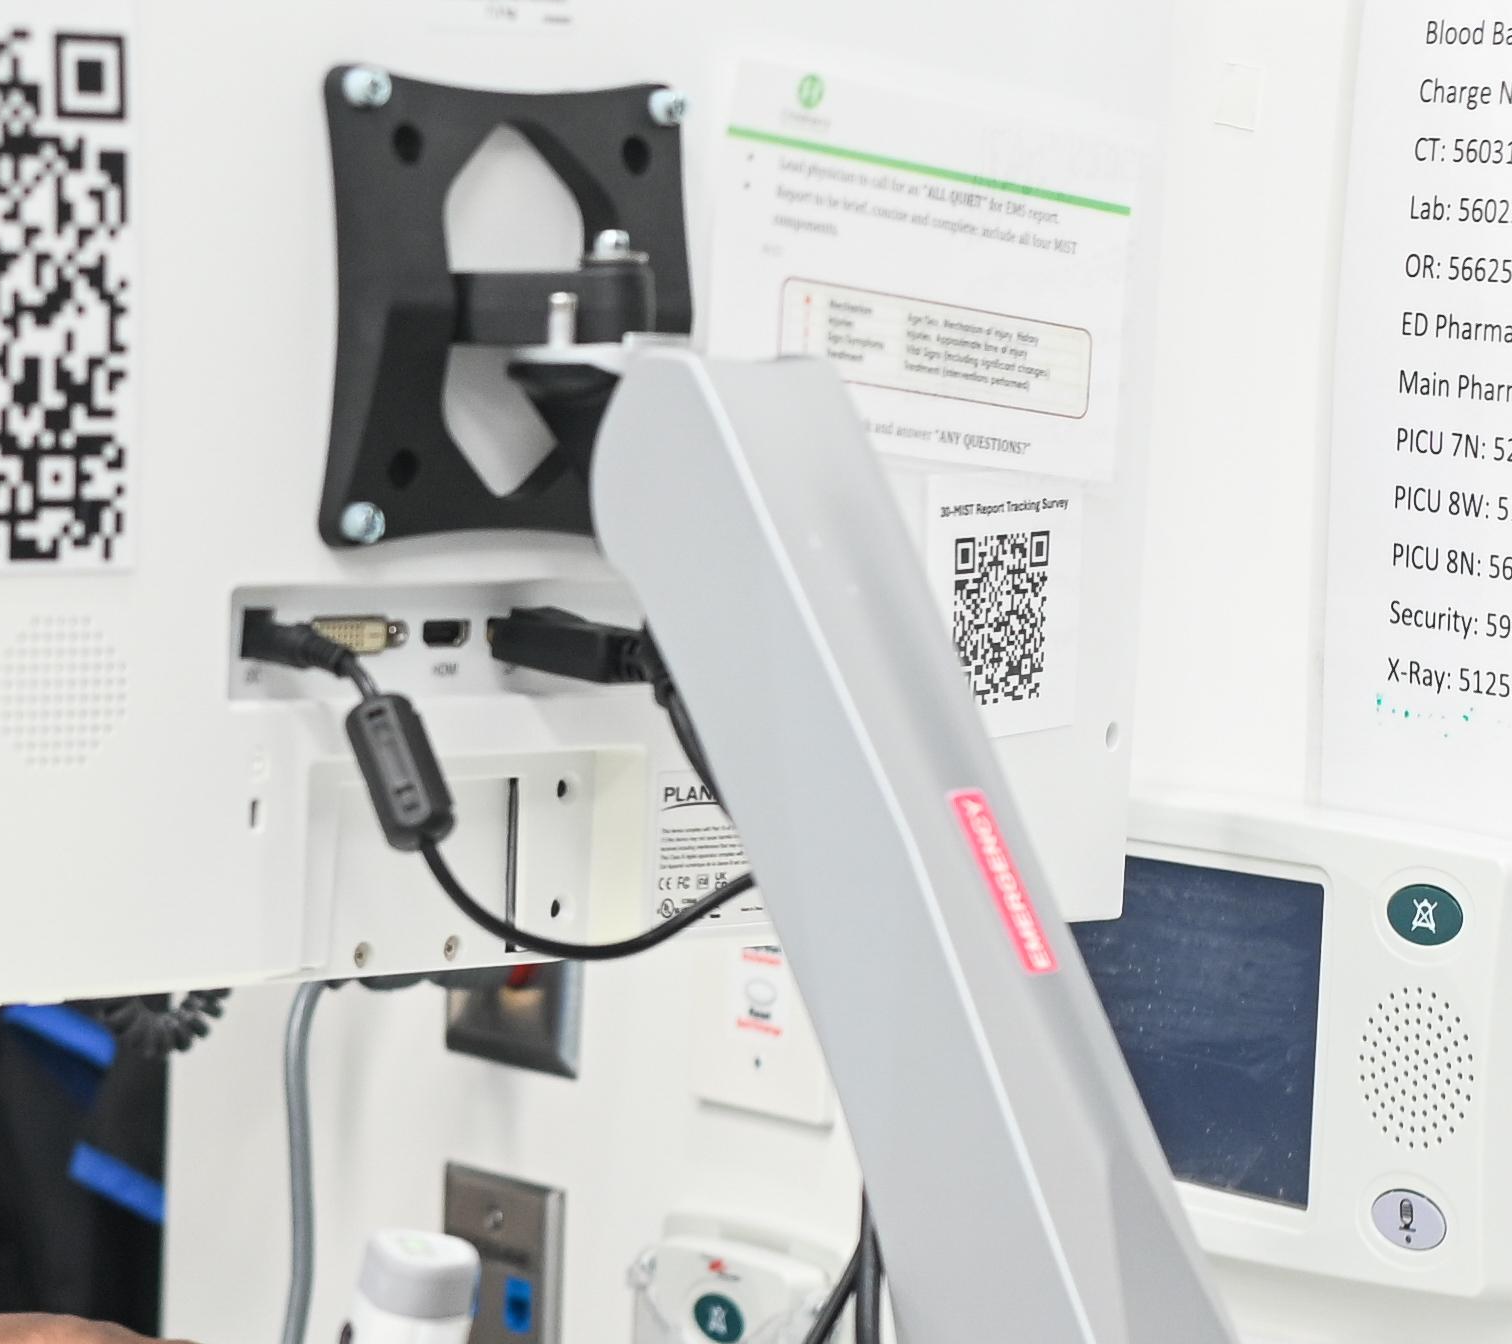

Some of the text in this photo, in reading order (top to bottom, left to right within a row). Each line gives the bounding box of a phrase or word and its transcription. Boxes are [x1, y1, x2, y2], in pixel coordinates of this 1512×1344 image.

[1425, 19, 1486, 46] Blood
[1419, 77, 1492, 111] Charge
[1414, 136, 1447, 163] CT:
[1409, 194, 1452, 222] Lab:
[1405, 252, 1442, 280] OR:
[1401, 311, 1429, 338] ED
[1398, 368, 1450, 398] Main
[1396, 426, 1444, 456] PICU
[1450, 431, 1486, 461] 7N:
[1394, 484, 1442, 514] PICU
[1447, 490, 1490, 520] 8W:
[1392, 542, 1440, 572] PICU
[1445, 548, 1482, 578] 8N:
[1388, 599, 1479, 641] Security:
[1386, 656, 1452, 695] X-Ray:
